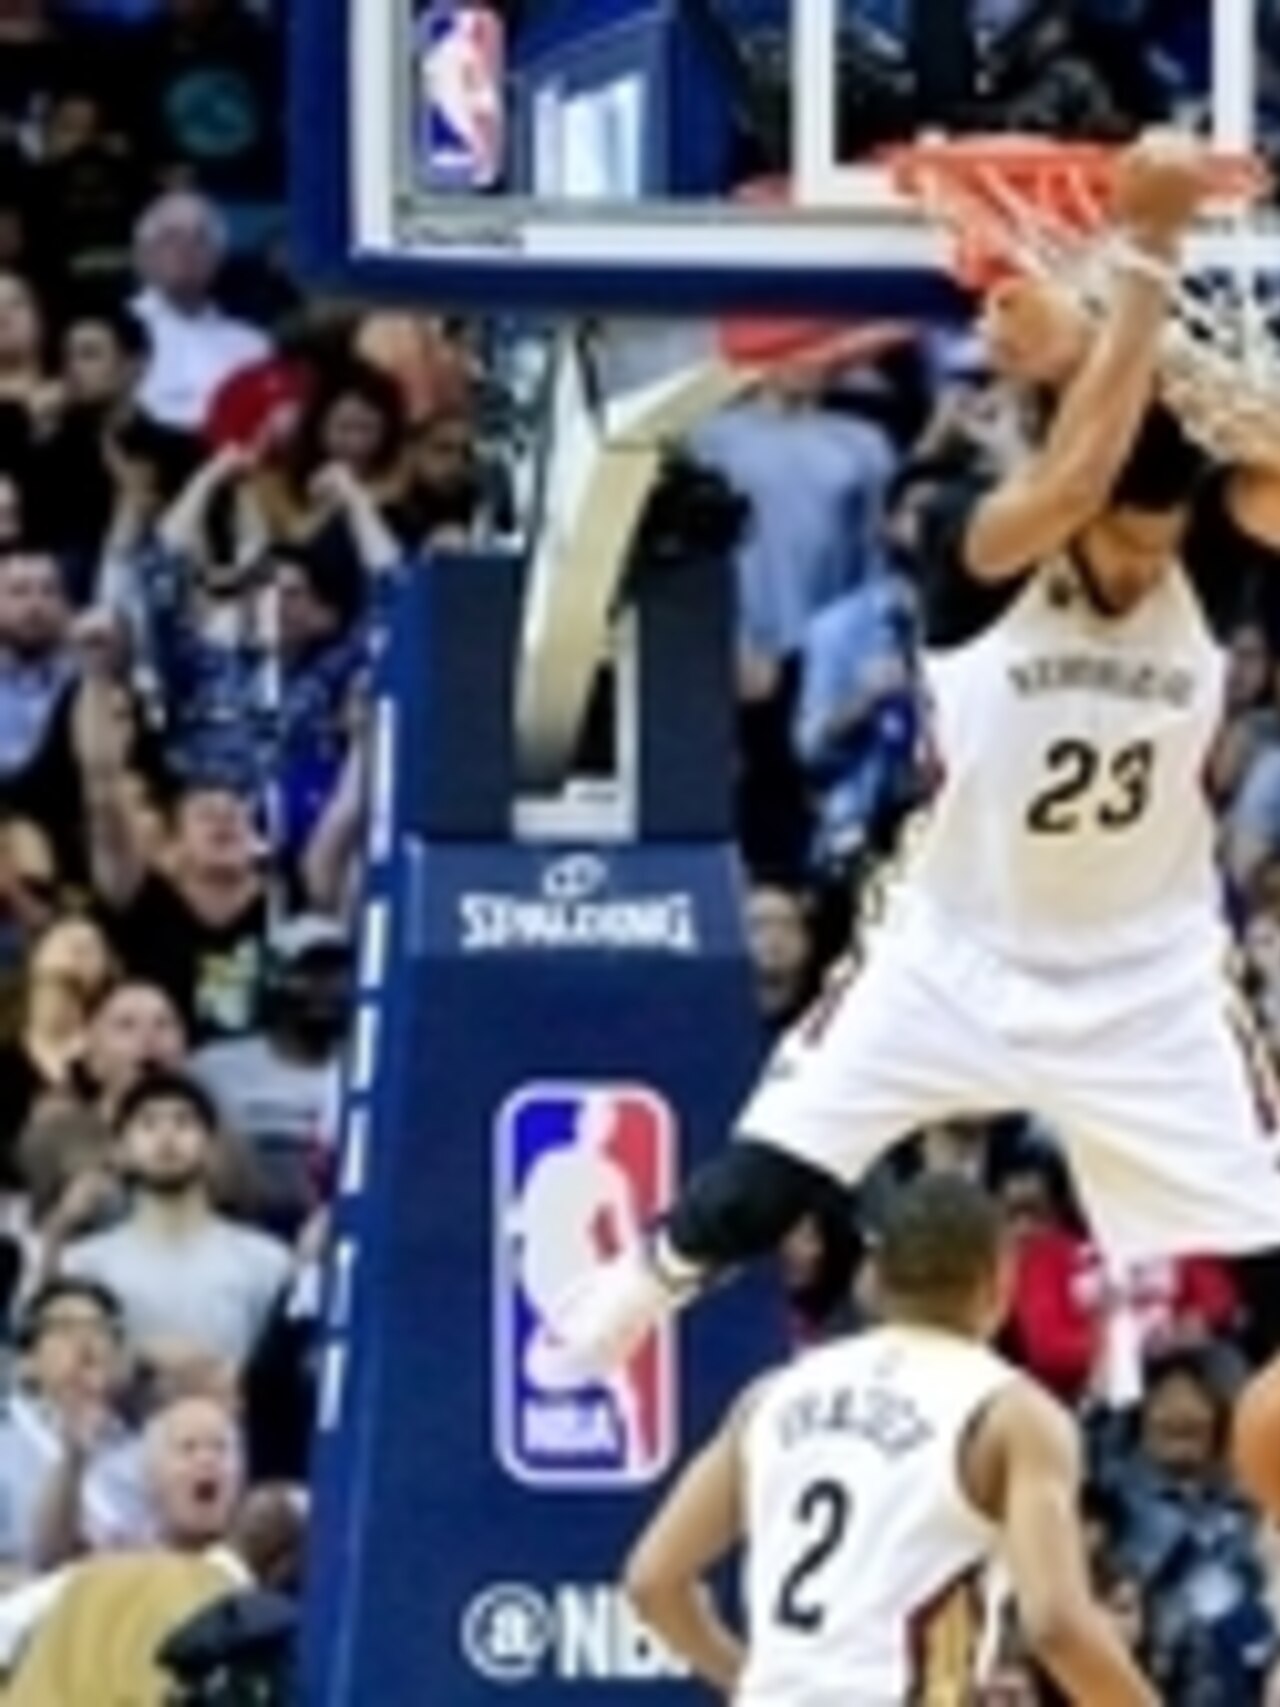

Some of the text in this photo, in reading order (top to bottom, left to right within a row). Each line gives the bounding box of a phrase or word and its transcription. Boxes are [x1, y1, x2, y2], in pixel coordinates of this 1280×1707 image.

[1027, 739, 1155, 833] 23
[460, 891, 699, 953] SPALDING
[774, 1474, 851, 1633] 2
[460, 1580, 692, 1687] @NB
